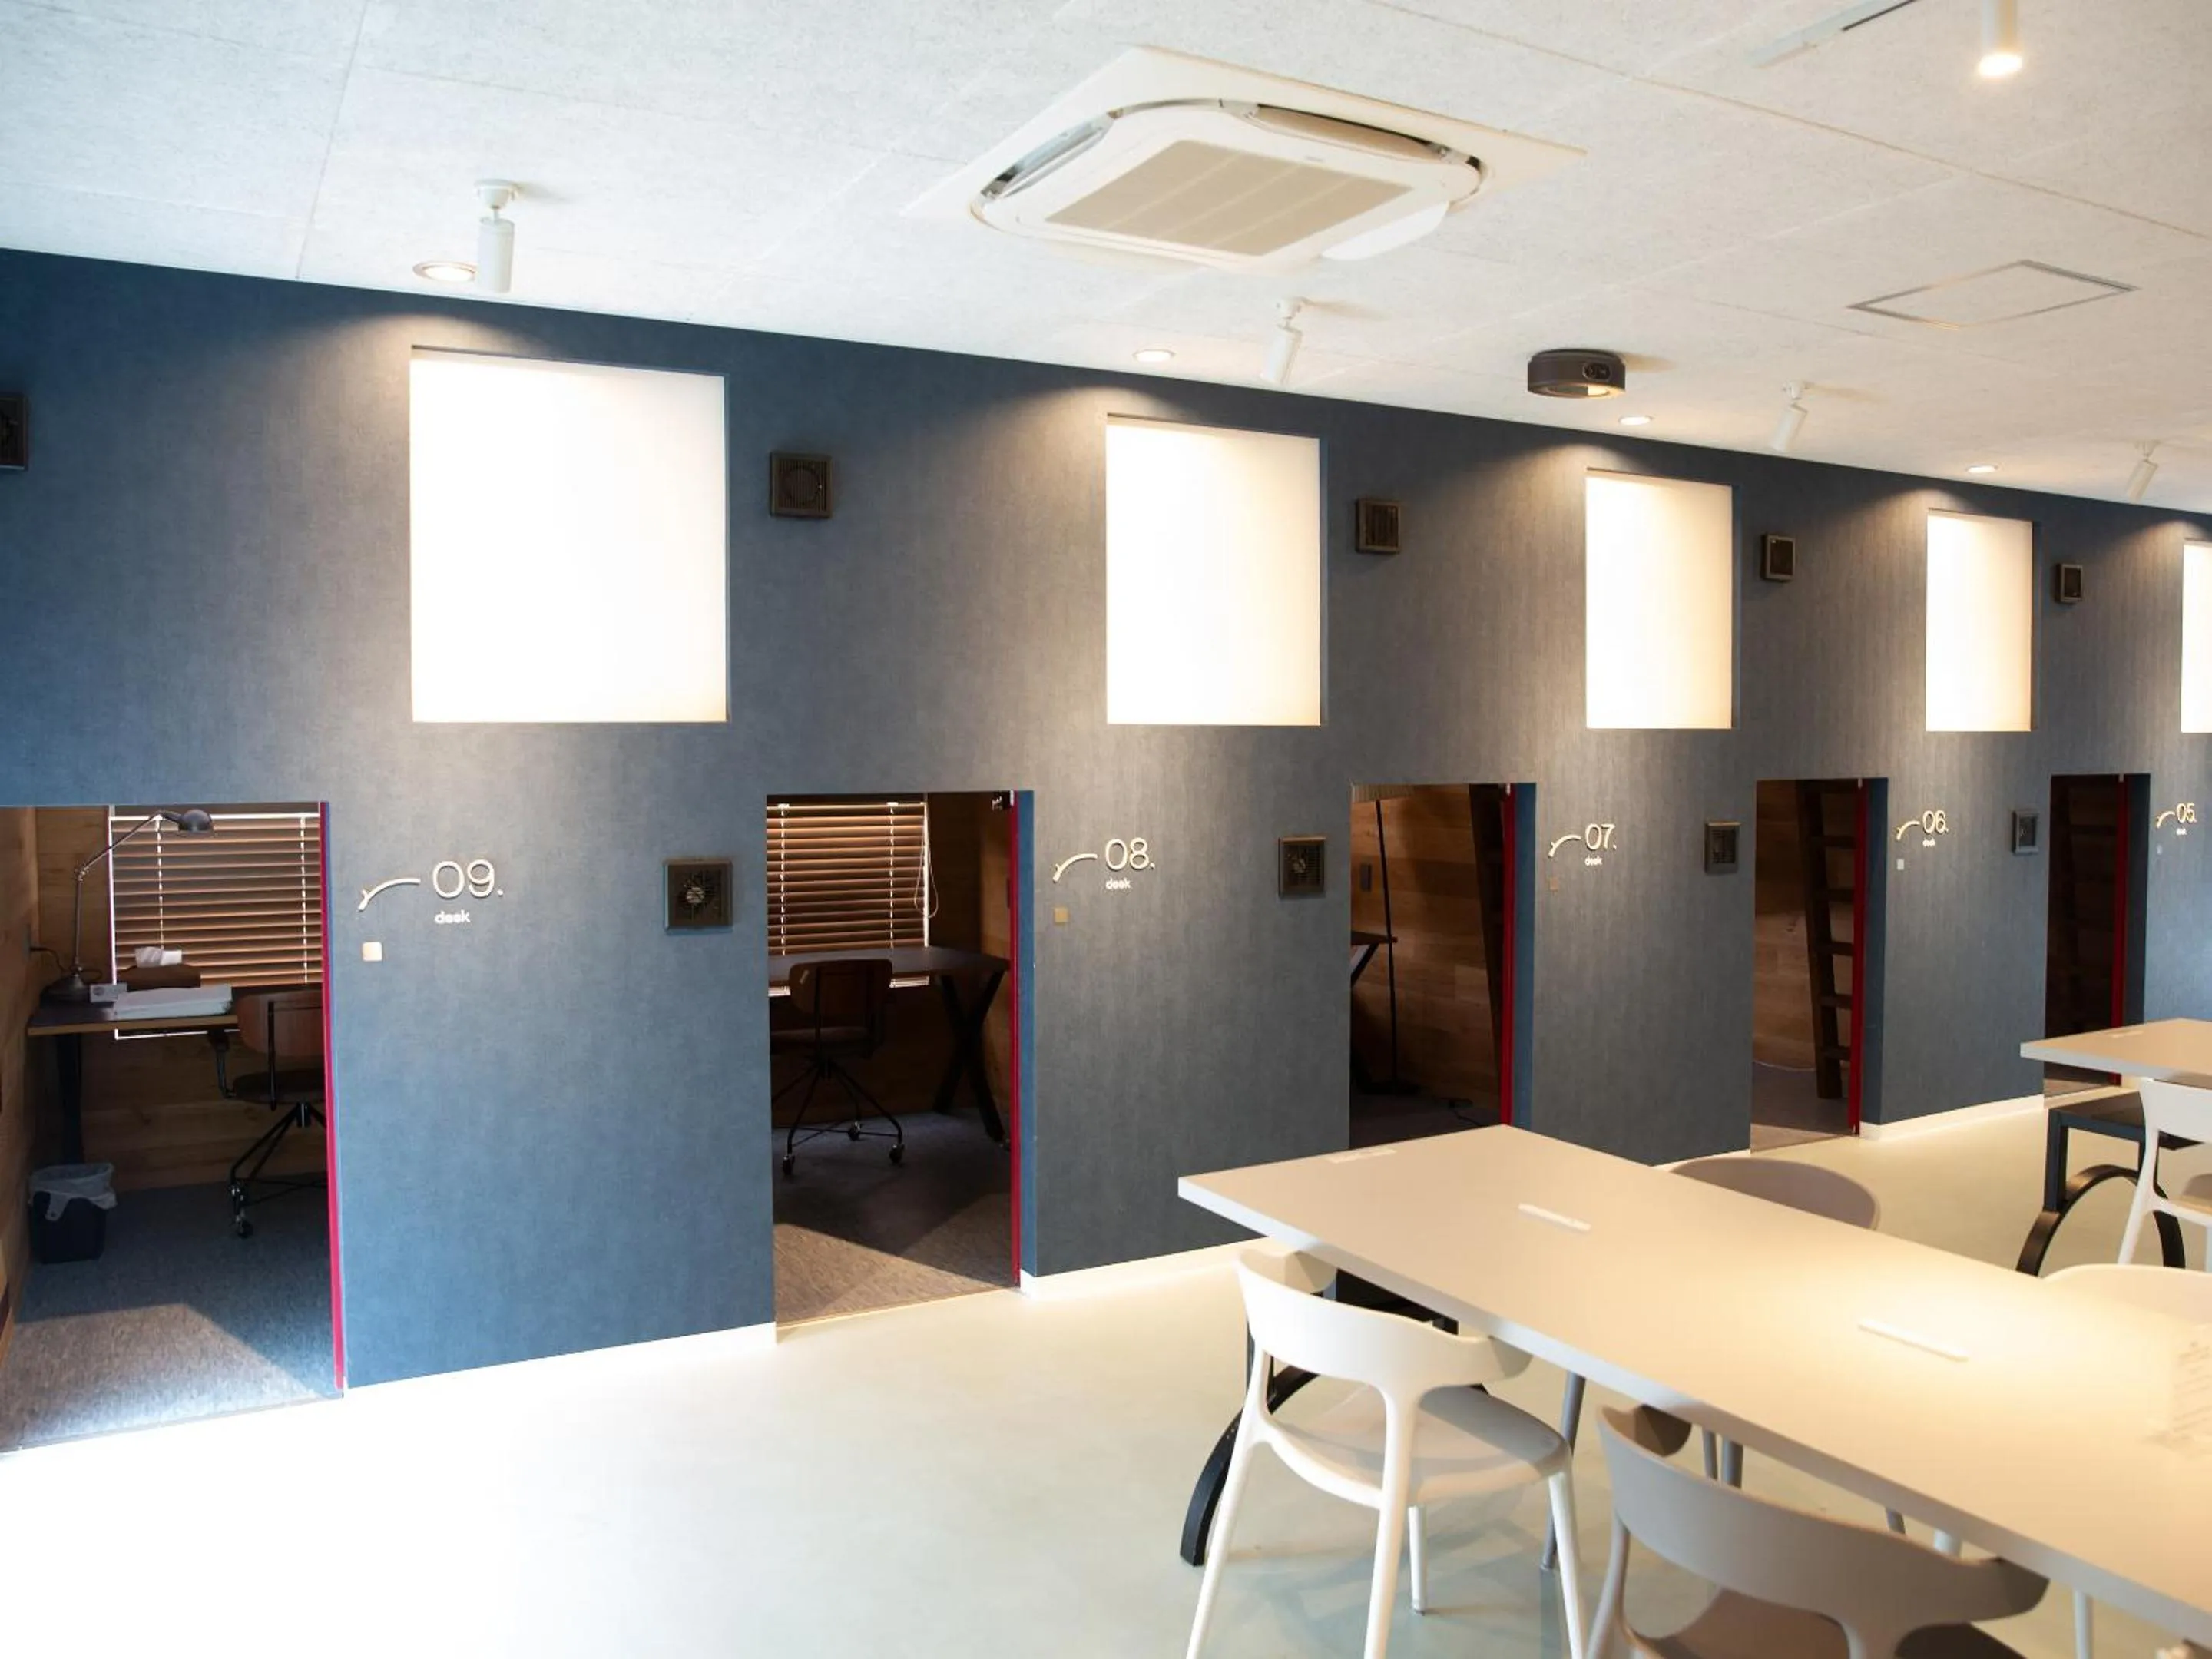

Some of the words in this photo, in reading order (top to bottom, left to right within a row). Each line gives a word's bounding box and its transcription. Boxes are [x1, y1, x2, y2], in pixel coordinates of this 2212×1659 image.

[1922, 810, 1949, 834] 06.
[1585, 823, 1617, 850] 07.
[1105, 837, 1155, 871] 08.
[433, 859, 504, 899] 09.
[435, 910, 471, 924] desk
